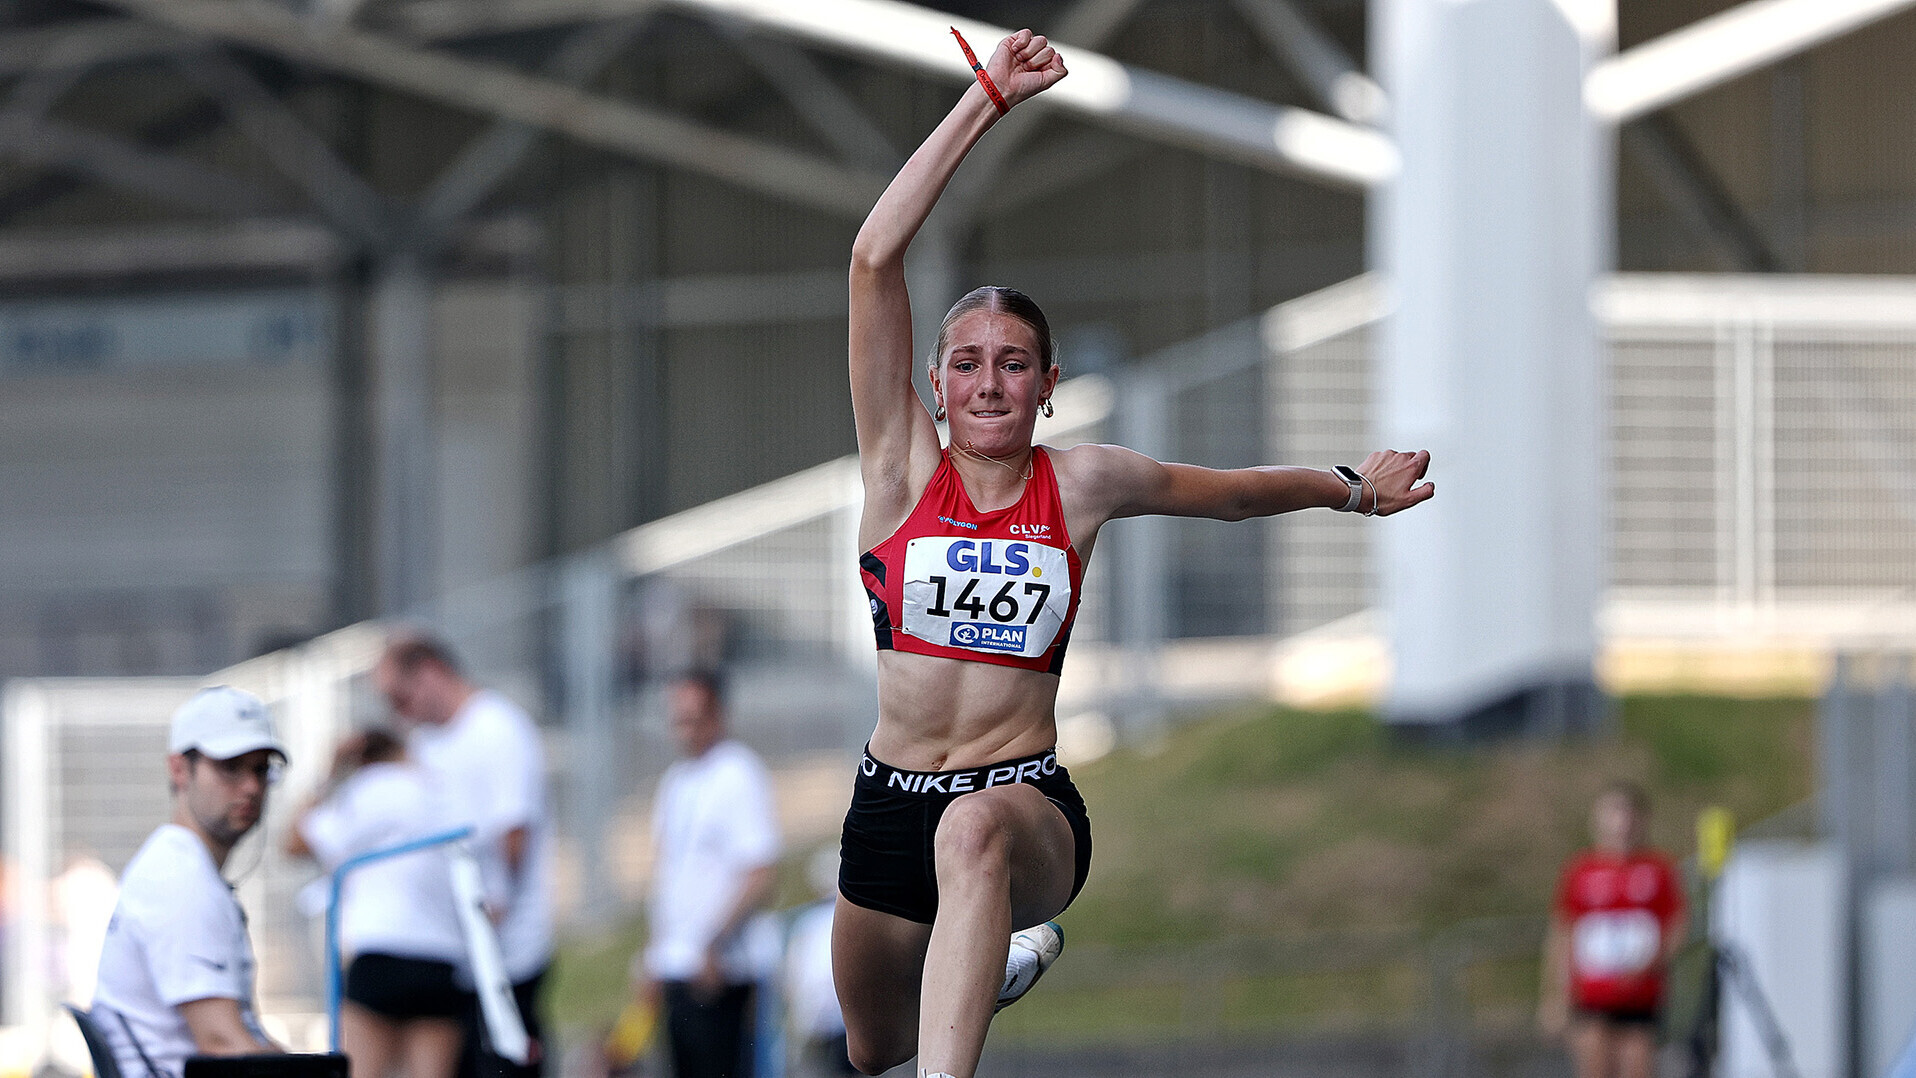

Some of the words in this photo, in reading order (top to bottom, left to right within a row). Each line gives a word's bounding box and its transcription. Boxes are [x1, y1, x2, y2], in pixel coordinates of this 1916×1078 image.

[926, 576, 1050, 625] 1467
[981, 640, 1022, 649] INTERNATIONAL
[982, 628, 1023, 643] PLAN
[888, 771, 978, 794] NIKE
[985, 753, 1057, 789] PRO
